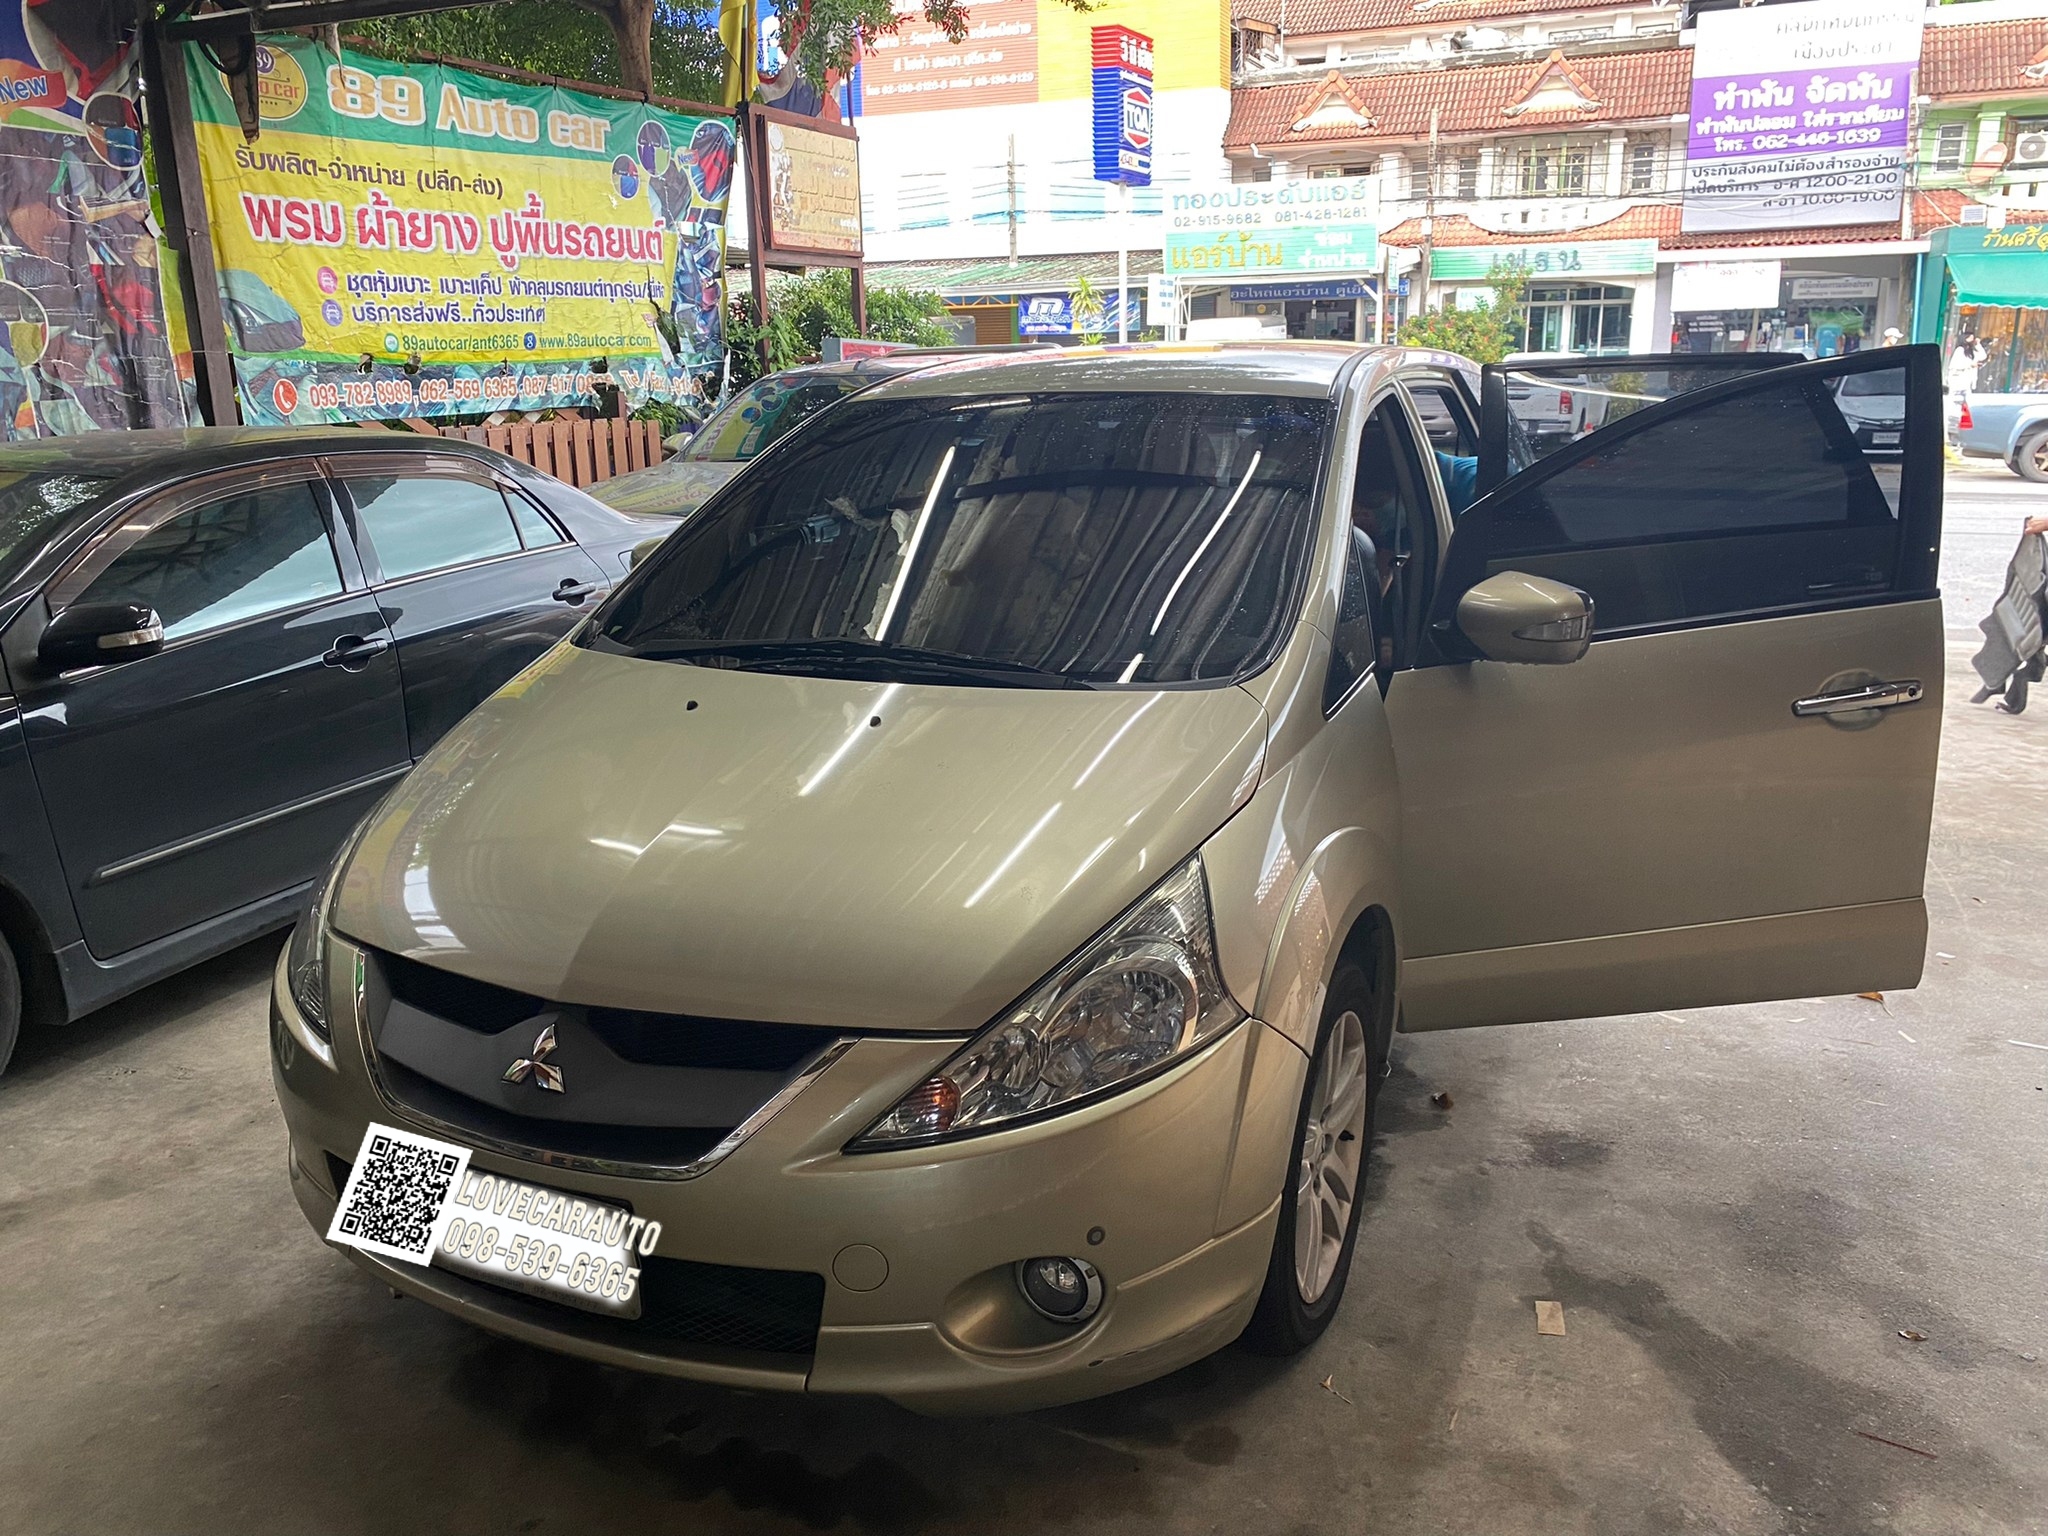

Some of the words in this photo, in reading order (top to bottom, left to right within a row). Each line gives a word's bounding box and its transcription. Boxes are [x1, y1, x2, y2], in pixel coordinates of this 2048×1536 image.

[0, 75, 48, 105] New
[1713, 79, 1794, 111] ทำฟัน
[1806, 71, 1893, 104] จัดฟัน
[327, 63, 426, 126] 89
[436, 82, 539, 143] Auto
[547, 109, 611, 153] car
[1126, 104, 1149, 133] TOA
[235, 144, 406, 187] รับผลิต-จำหน่าย
[416, 168, 504, 200] (ปลีก-ส่ง)
[1173, 178, 1367, 210] ทองประดับแอร์
[241, 194, 343, 244] พรม
[356, 189, 479, 251] ผ้ายาง
[490, 191, 664, 270] ปูพื้นรถยนต์
[1173, 212, 1262, 228] 02-915-9682
[1171, 231, 1284, 269] แอร์บ้าน
[346, 271, 431, 298] ชุดหุ้มเบาะ
[540, 332, 652, 350] www.89autocar.com
